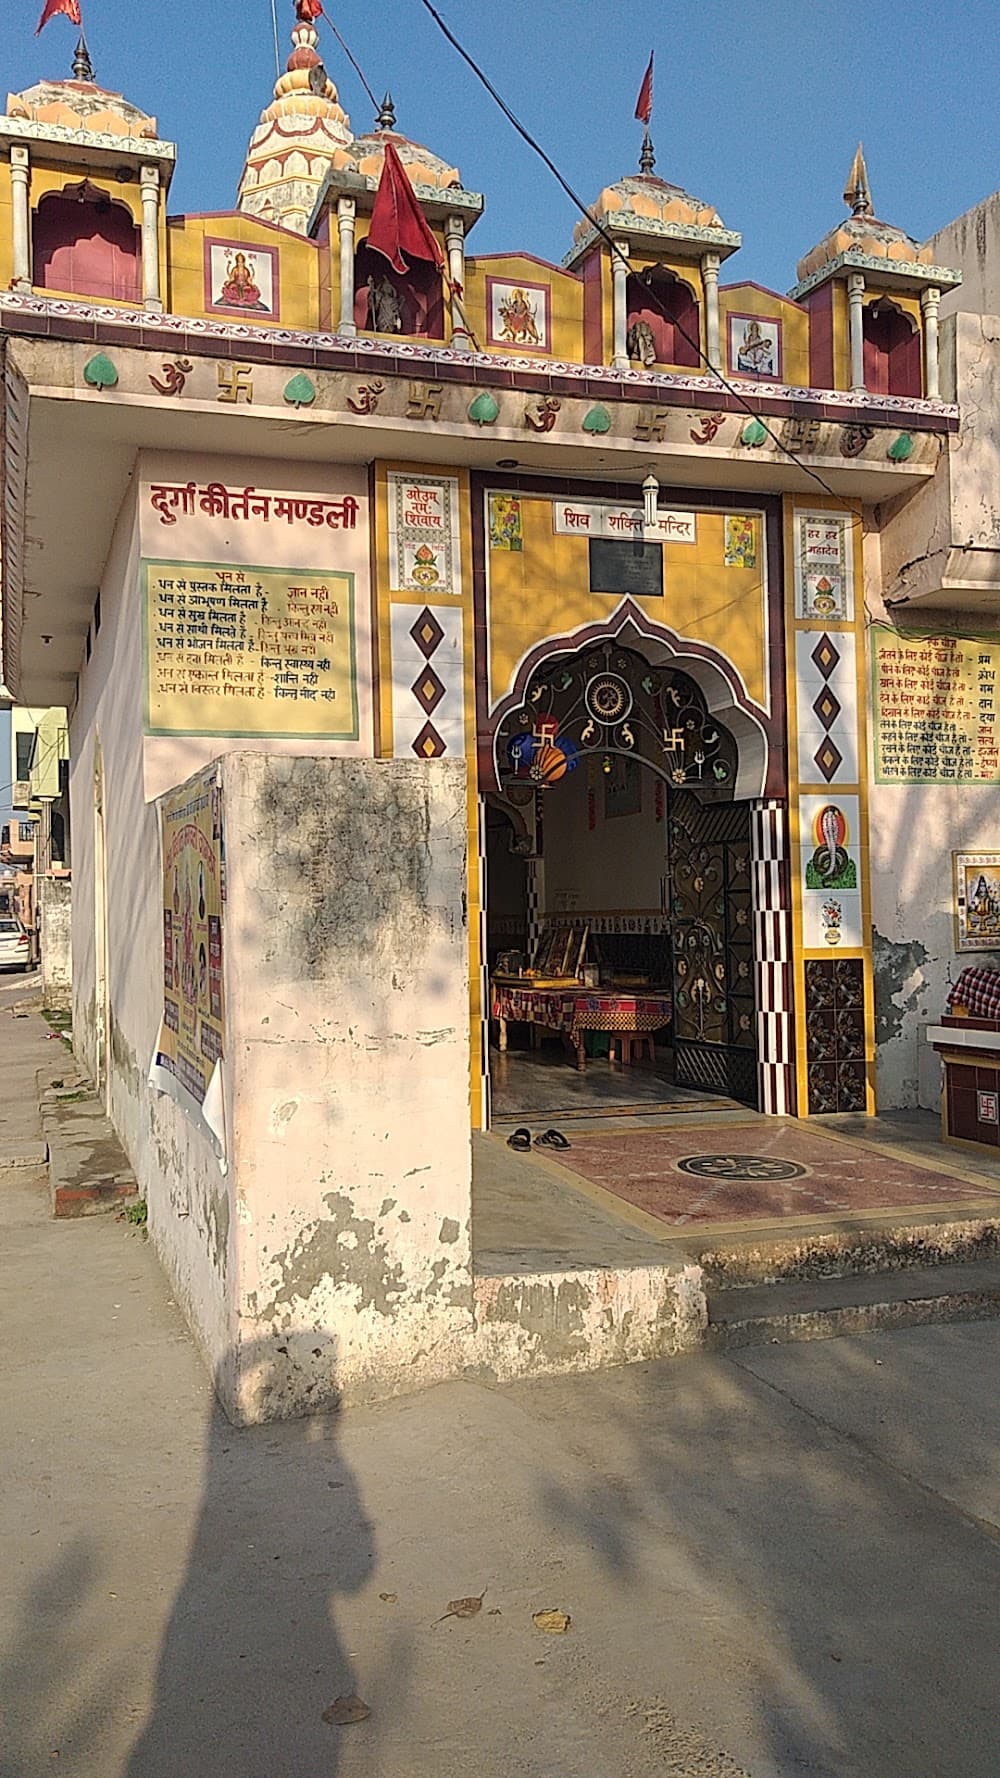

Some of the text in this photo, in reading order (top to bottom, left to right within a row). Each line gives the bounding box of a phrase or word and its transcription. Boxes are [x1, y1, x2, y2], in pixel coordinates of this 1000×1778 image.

[150, 482, 360, 529] दुर्गा कीर्तन मण्डली
[404, 510, 442, 528] शिवाय
[564, 508, 692, 536] शिव शक्ति मन्दिर
[808, 530, 838, 540] हर हर
[808, 544, 838, 556] महादेव
[158, 580, 173, 589] धन
[176, 578, 186, 590] से
[190, 582, 217, 592] पुस्तक
[220, 581, 250, 594] मिलता
[255, 582, 262, 597] है
[159, 594, 174, 604] धन
[177, 592, 186, 604] से
[189, 595, 226, 608] आभूषण
[229, 596, 258, 609] मिलता
[158, 608, 174, 618] धन
[178, 606, 186, 619] से
[188, 610, 205, 622] सुख
[208, 609, 236, 622] मिलता
[159, 622, 173, 632] धन
[157, 638, 172, 648] धन
[176, 636, 184, 648] से
[187, 636, 212, 650] भोजन
[216, 638, 244, 651] मिलता
[222, 668, 254, 682] मिलता
[160, 684, 176, 694] धन
[980, 684, 994, 694] गम
[979, 698, 992, 709] दान
